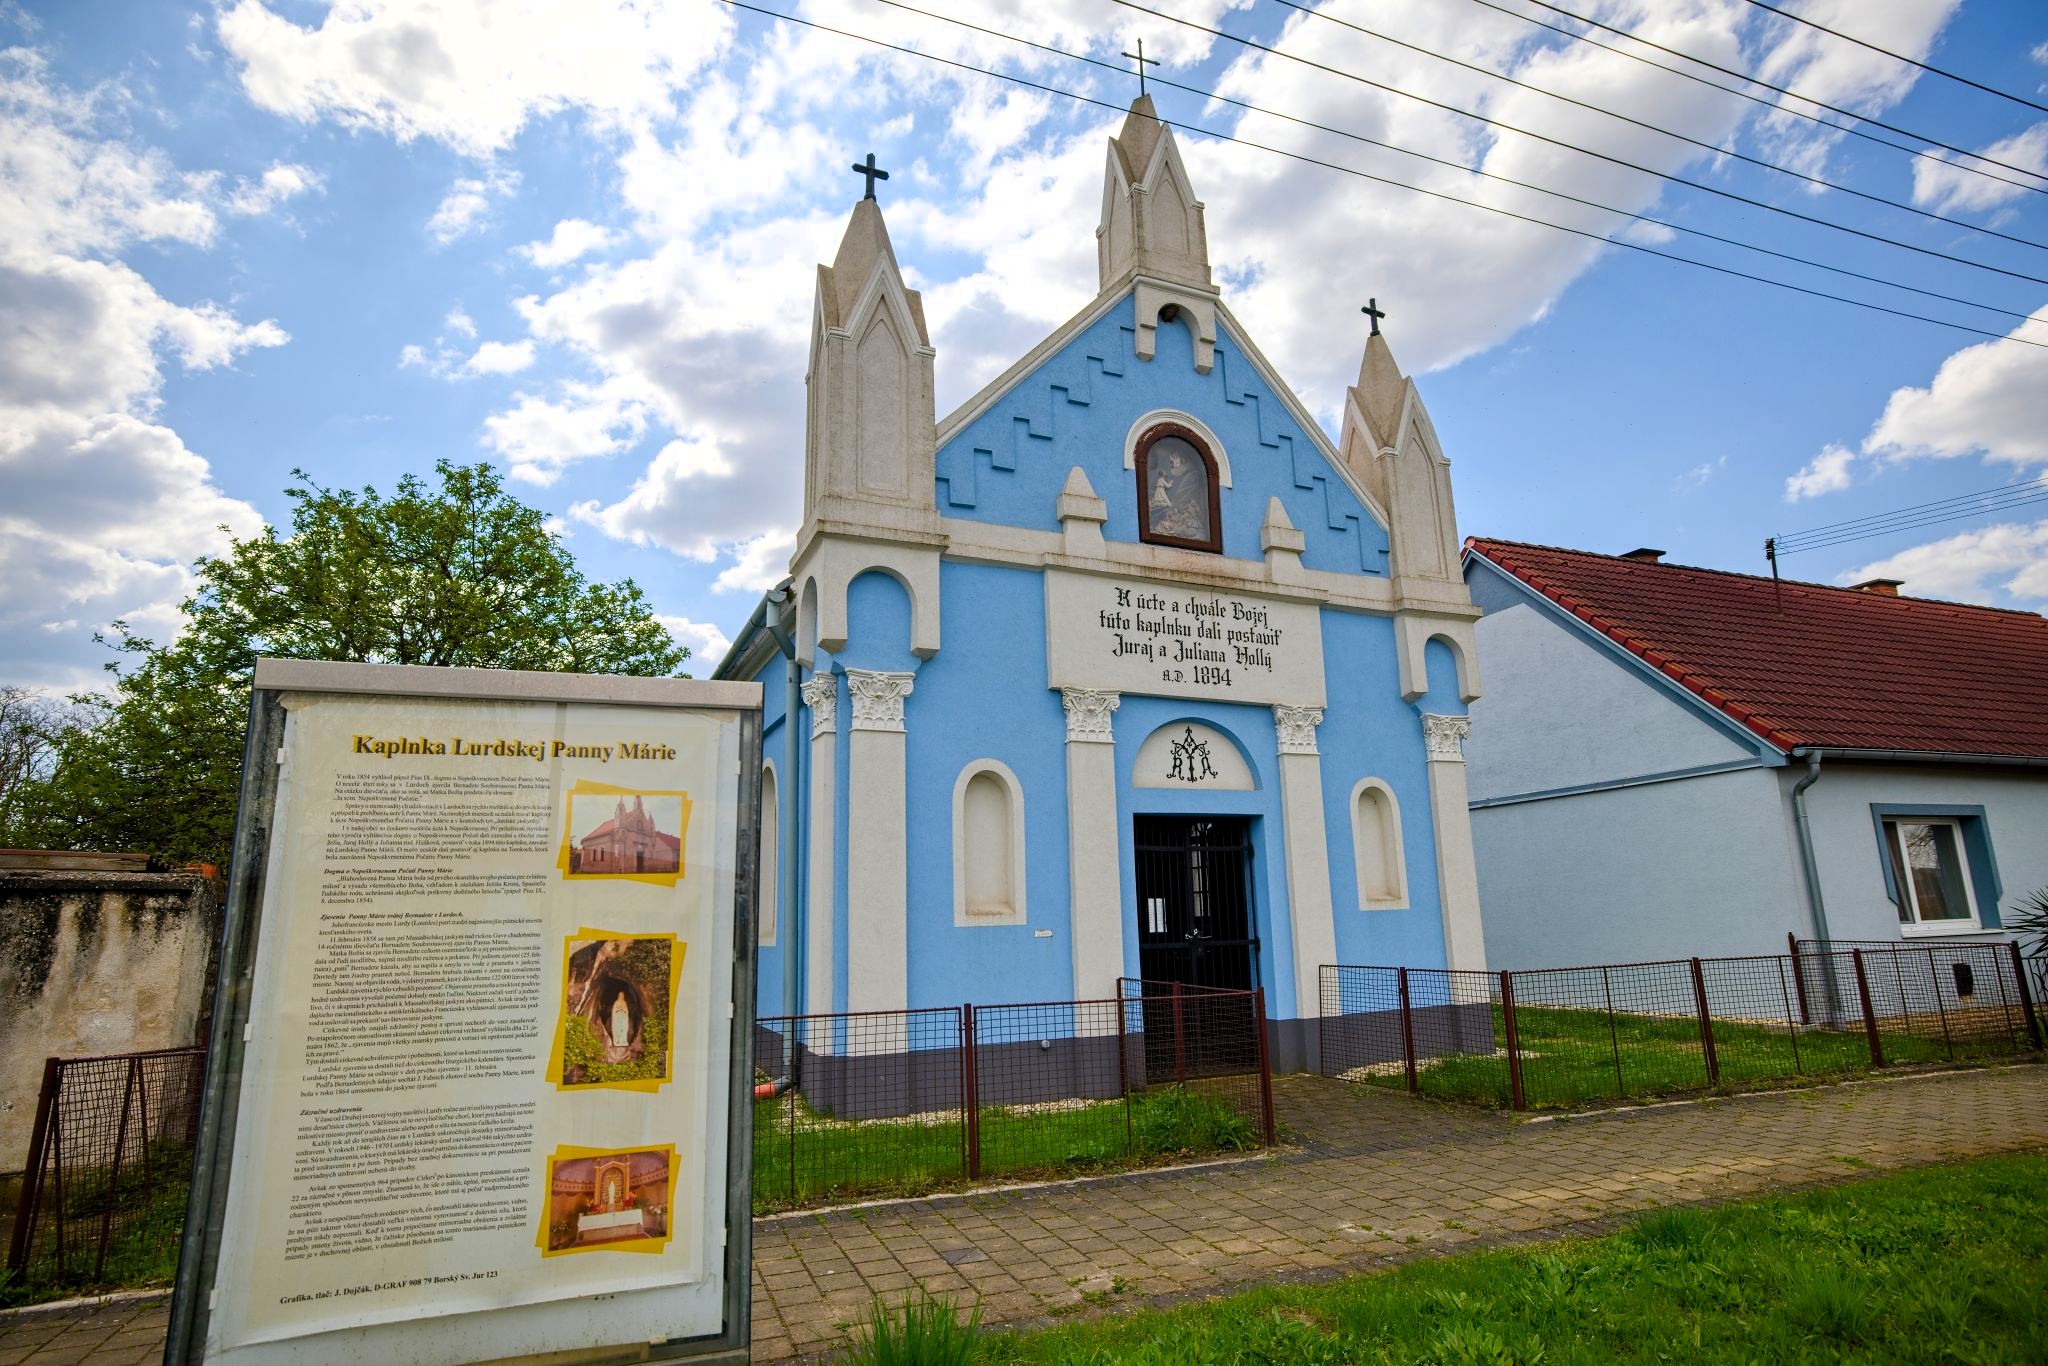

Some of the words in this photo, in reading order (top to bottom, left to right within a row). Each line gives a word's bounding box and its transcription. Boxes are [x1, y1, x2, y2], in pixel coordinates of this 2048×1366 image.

[1115, 587, 1131, 608] K
[1137, 594, 1166, 611] úcte
[1172, 602, 1179, 612] a
[1185, 597, 1227, 621] chvále
[1231, 602, 1268, 628] Božej
[1100, 610, 1130, 631] túto
[1137, 613, 1191, 639] kaplnku
[1197, 620, 1222, 640] dali
[1227, 627, 1282, 646] postaviť
[1112, 634, 1154, 663] Juraj
[1160, 645, 1167, 657] a
[1174, 639, 1226, 663] Juliana
[1235, 645, 1272, 672] Hollý
[1194, 665, 1232, 687] 1894
[352, 735, 446, 759] Kaplnka
[451, 737, 545, 762] Lurdskej
[552, 740, 614, 763] Panny
[618, 741, 677, 761] Márie
[279, 1293, 314, 1305] Grafika,
[315, 1289, 332, 1300] tlač:
[334, 1288, 342, 1297] J.
[343, 1283, 372, 1296] Dojčák,
[374, 1280, 408, 1292] D-GRAF
[424, 1277, 432, 1285] 79
[434, 1274, 459, 1284] Borský
[460, 1272, 470, 1281] Sv.
[472, 1271, 485, 1279] Jur
[486, 1270, 498, 1278] 123
